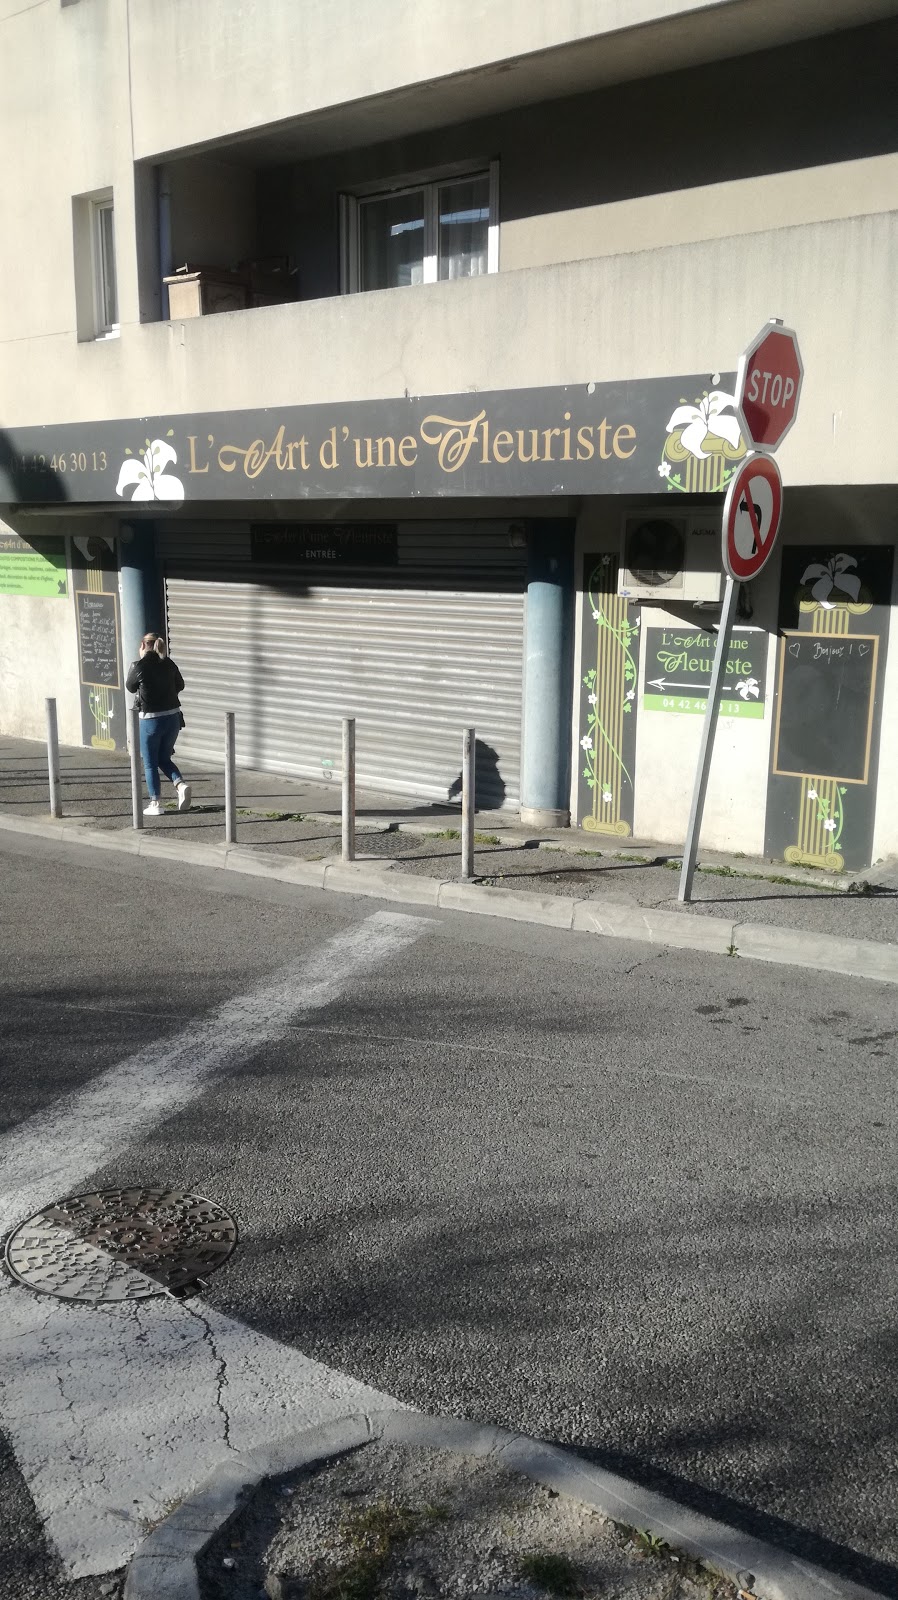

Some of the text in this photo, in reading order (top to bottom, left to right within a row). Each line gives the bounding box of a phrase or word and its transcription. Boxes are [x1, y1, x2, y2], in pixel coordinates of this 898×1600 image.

[748, 369, 795, 409] STOP
[187, 409, 637, 479] L'Art d'une Fleuriste
[50, 453, 67, 473] 46
[70, 452, 87, 472] 30
[92, 451, 108, 471] 13
[305, 548, 337, 559] ENTRÉE
[662, 633, 711, 648] L'Art
[656, 651, 753, 675] Fleurste
[663, 698, 675, 708] 04
[678, 700, 691, 710] 42
[694, 701, 707, 711] 46
[728, 703, 740, 713] 13
